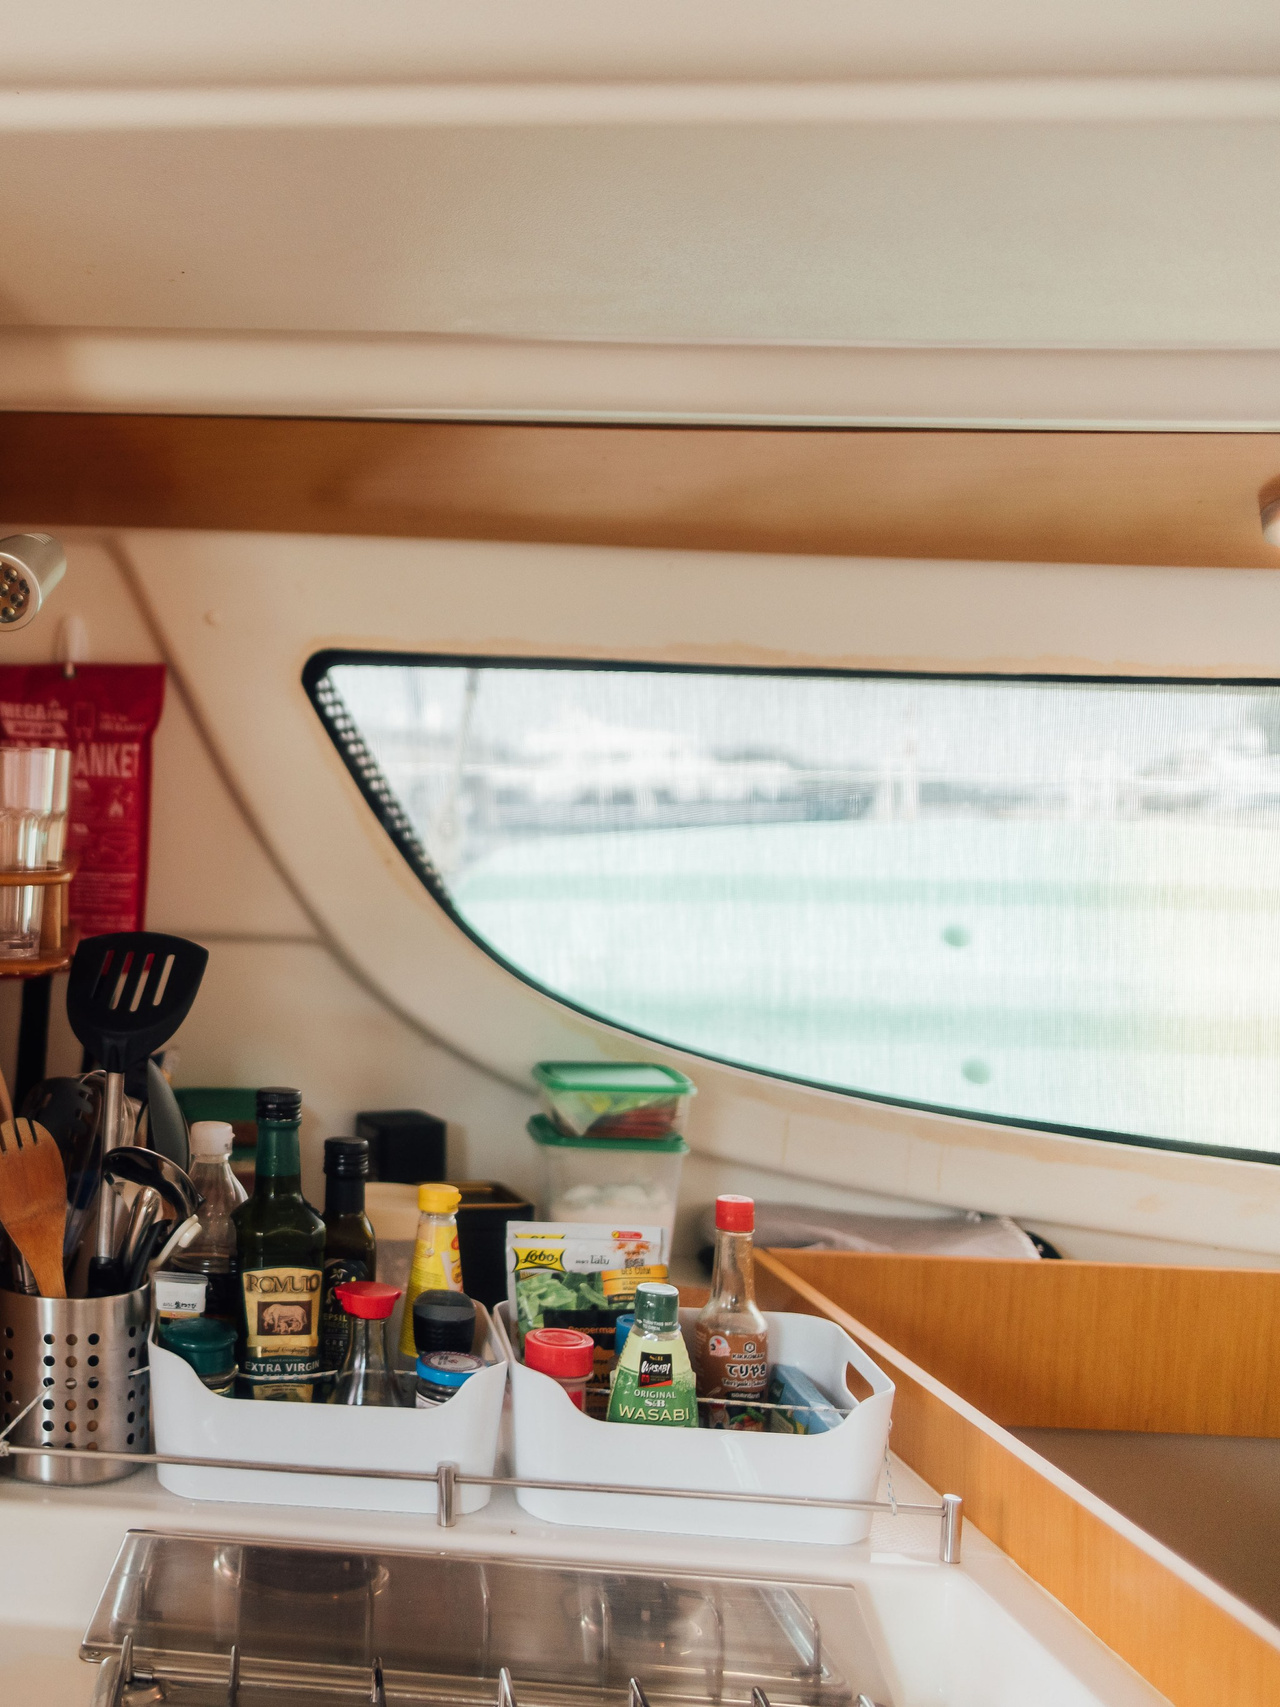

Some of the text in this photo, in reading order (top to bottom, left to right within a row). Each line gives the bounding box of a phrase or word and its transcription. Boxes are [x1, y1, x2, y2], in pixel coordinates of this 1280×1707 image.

[520, 1250, 559, 1266] Lobo
[246, 1273, 320, 1294] ROMULO
[731, 1353, 765, 1361] KIKKOMAN
[245, 1361, 282, 1372] EXTRA
[285, 1359, 320, 1372] VIRGIN
[641, 1360, 672, 1375] WASABI
[723, 1378, 752, 1388] Teriyaki
[634, 1389, 677, 1399] ORIGINAL
[644, 1399, 666, 1408] S&B
[618, 1403, 690, 1421] WASABI
